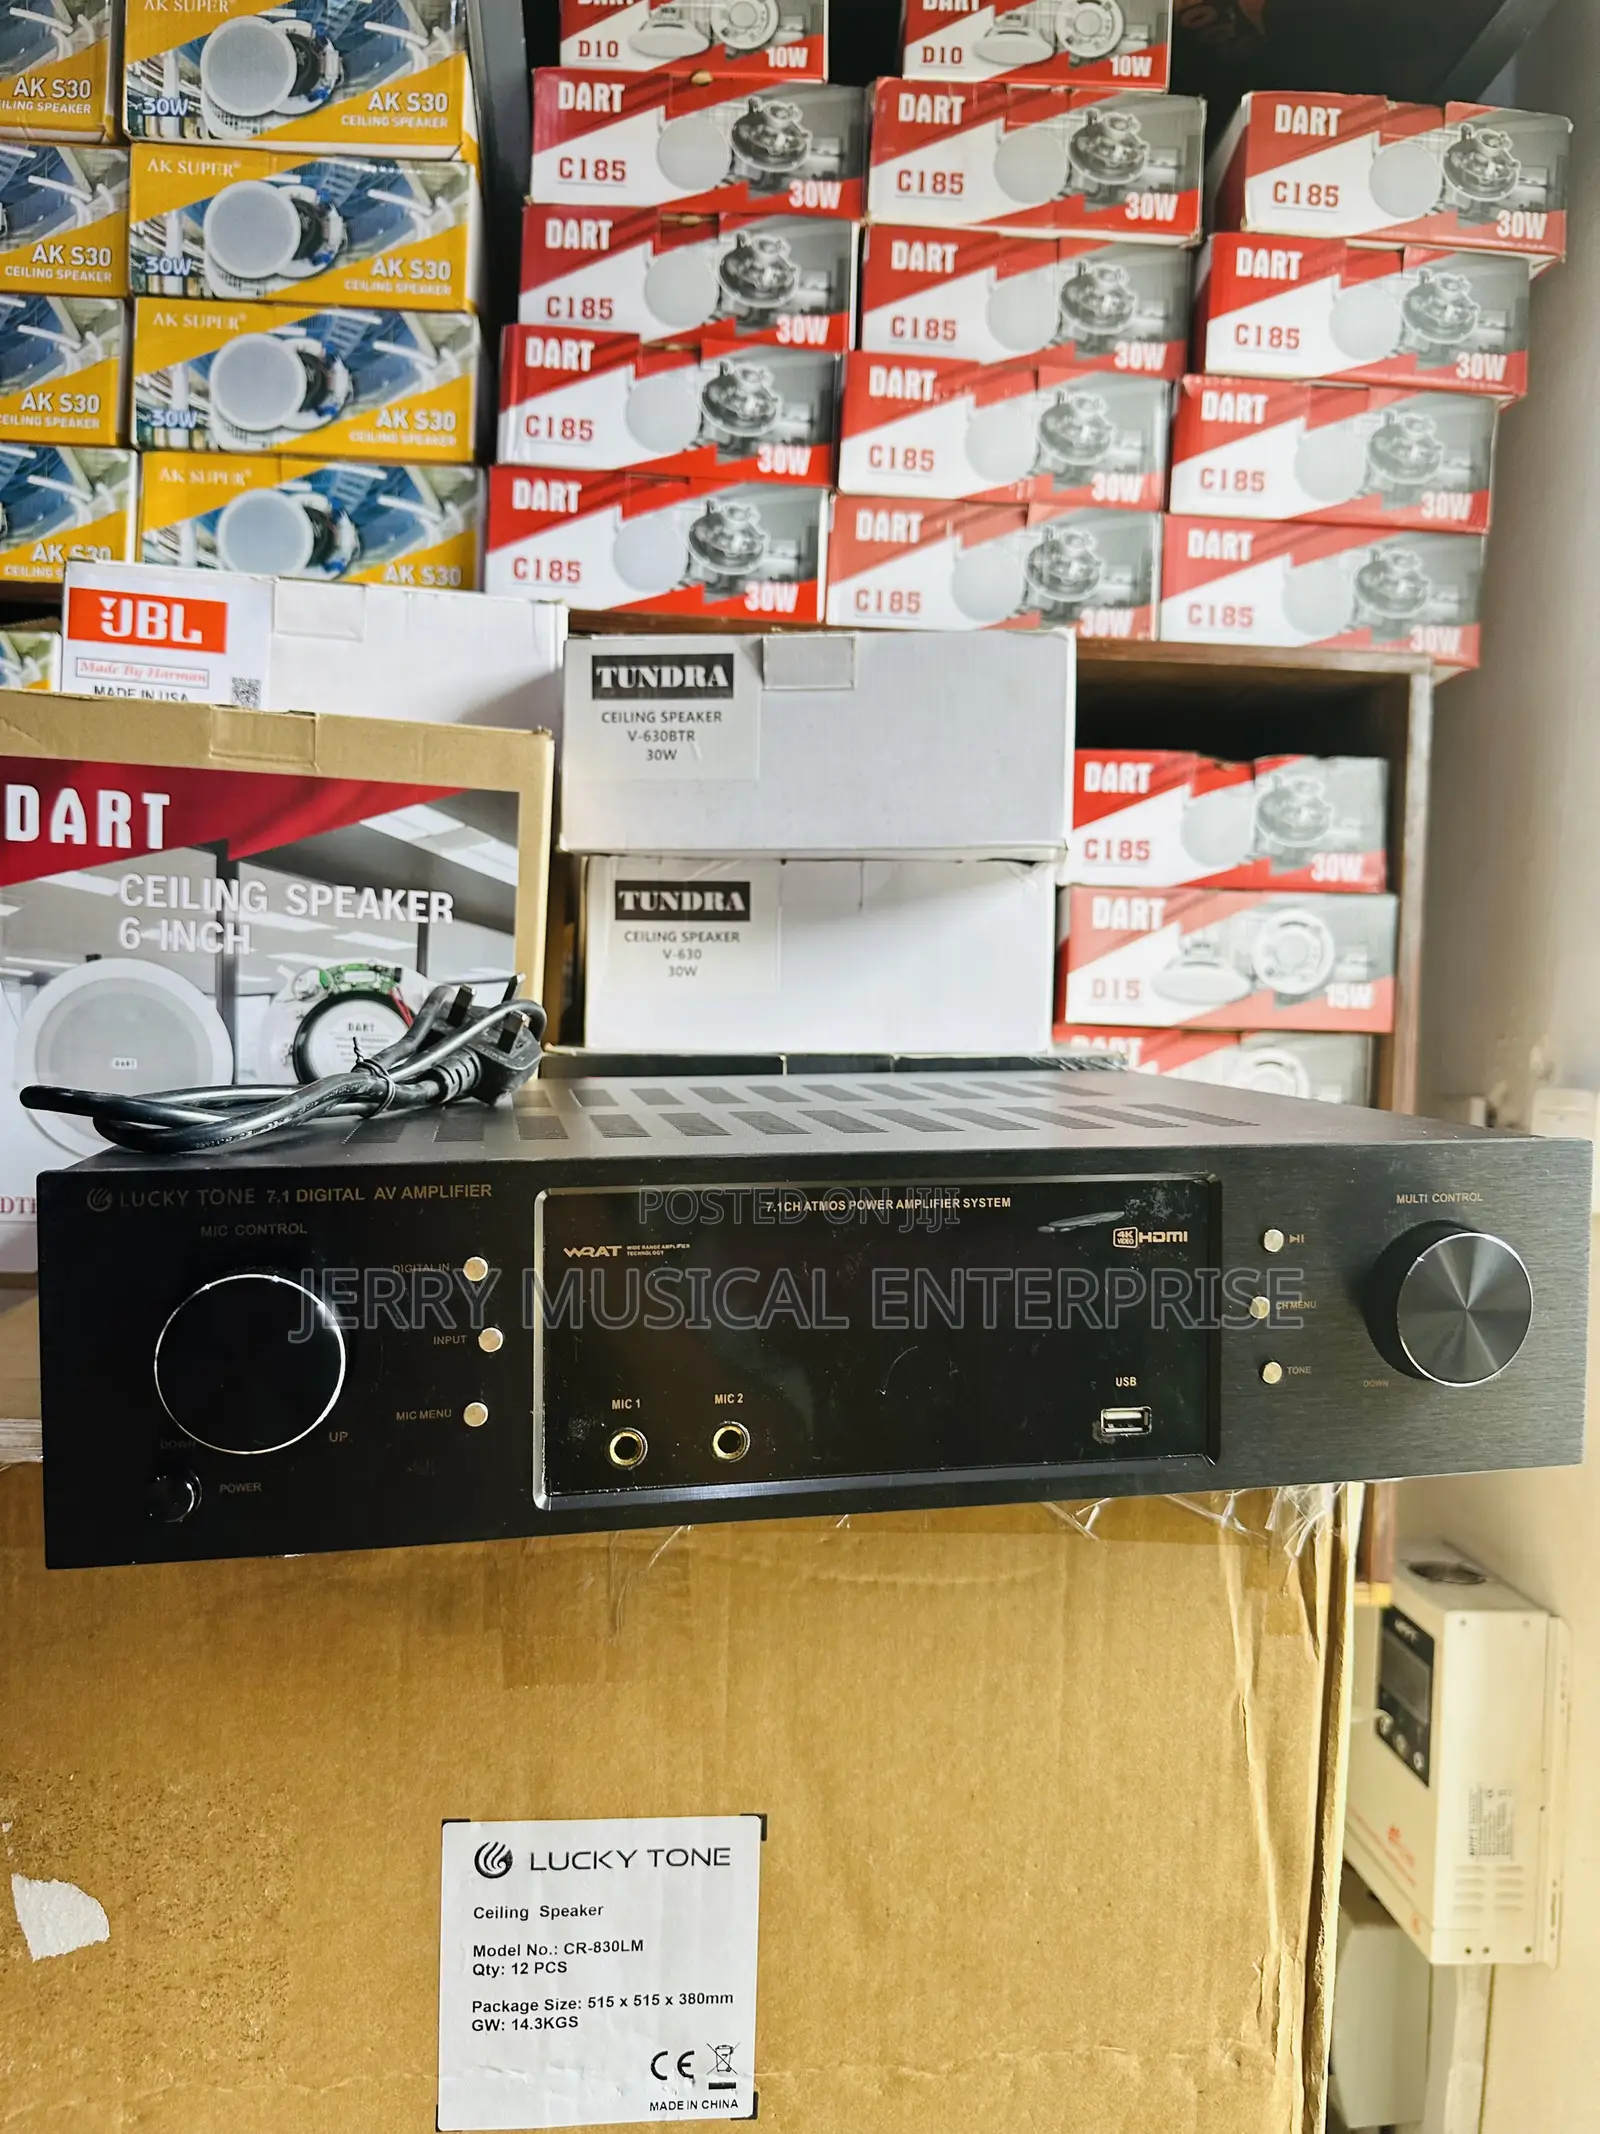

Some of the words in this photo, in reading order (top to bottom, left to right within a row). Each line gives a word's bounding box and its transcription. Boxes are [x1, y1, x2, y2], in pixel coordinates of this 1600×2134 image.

[578, 41, 619, 57] D10
[765, 47, 808, 68] 10W
[922, 47, 963, 64] D10
[1110, 55, 1153, 77] 10W
[13, 76, 46, 97] AK
[52, 79, 91, 99] S30
[558, 81, 625, 112] DART
[37, 103, 91, 114] SPEAKER
[368, 92, 400, 111] AK
[406, 93, 447, 112] S30
[898, 93, 966, 125] DART
[341, 115, 387, 125] CEILING
[392, 117, 448, 128] SPEAKER
[1275, 104, 1342, 137] DART
[147, 158, 172, 173] AK
[559, 157, 627, 181] C185
[897, 170, 964, 194] C185
[788, 182, 842, 209] 30W
[1273, 182, 1339, 207] C185
[1124, 193, 1178, 220] 30W
[545, 219, 613, 250] DART
[1496, 210, 1547, 239] 30W
[32, 244, 64, 264] AK
[71, 247, 111, 266] S30
[891, 240, 958, 273] DART
[1236, 248, 1303, 280] DART
[371, 258, 404, 278] AK
[410, 260, 451, 280] S30
[546, 296, 613, 320] C185
[776, 315, 829, 344] 30W
[892, 316, 957, 341] C185
[1235, 324, 1300, 349] C185
[525, 336, 595, 371] DART
[1114, 341, 1167, 371] 30W
[1456, 352, 1506, 381] 30W
[869, 365, 936, 400] DART
[21, 391, 53, 411] AK
[60, 393, 100, 413] S30
[1201, 390, 1268, 424] DART
[376, 408, 409, 428] AK
[414, 410, 456, 431] S30
[526, 415, 593, 440] C185
[757, 444, 811, 475] 30W
[869, 445, 934, 470] C185
[1091, 472, 1144, 503] 30W
[1201, 467, 1265, 492] C185
[512, 478, 582, 513] DART
[1421, 492, 1473, 520] 30W
[855, 509, 923, 543] DART
[1187, 529, 1254, 561] DART
[513, 558, 582, 582] C185
[744, 582, 798, 613] 30W
[855, 590, 920, 613] C185
[100, 597, 202, 644] JBL
[1080, 608, 1133, 638] 30W
[596, 665, 729, 688] TUNDRA
[601, 712, 656, 723] CEILING
[661, 711, 722, 723] SPEAKER
[627, 730, 695, 742] V-630BTR
[646, 749, 677, 761] 30W
[1084, 762, 1153, 794] DART
[4, 784, 171, 850] DART
[1084, 839, 1150, 861] C185
[119, 873, 268, 914] CEILING
[285, 884, 453, 924] SPEAKER
[618, 890, 745, 911] TUNDRA
[1092, 897, 1166, 930] DART
[160, 918, 251, 955] INCH
[624, 931, 677, 943] CEILING
[681, 931, 740, 943] SPEAKER
[663, 949, 702, 960] V-630
[668, 966, 697, 977] 30W
[1325, 983, 1374, 1010] 15W
[119, 1191, 188, 1208] LUCKY
[197, 1188, 256, 1206] TONE
[267, 1188, 289, 1204] 7.1
[296, 1187, 365, 1202] DIGITAL
[374, 1186, 398, 1200] AV
[400, 1184, 492, 1199] AMPLIFIER
[766, 1201, 800, 1213] 7.1CH
[803, 1200, 846, 1211] ATMOS
[849, 1198, 893, 1210] POWER
[896, 1198, 960, 1209] AMPLIFIER
[963, 1197, 1011, 1208] SYSTEM
[1396, 1194, 1428, 1204] MULTI
[1432, 1192, 1483, 1203] CONTROL
[200, 1224, 229, 1237] MIC
[235, 1223, 307, 1236] CONTROL
[1117, 1230, 1133, 1238] 4K
[1139, 1231, 1188, 1243] HDMI
[392, 1264, 436, 1273] DIGITAL
[438, 1263, 450, 1272] IN
[433, 1335, 467, 1345] INPUT
[1115, 1376, 1137, 1387] USB
[1287, 1366, 1311, 1375] TONE
[1363, 1379, 1389, 1388] DOWN
[612, 1400, 631, 1409] MIC
[636, 1399, 641, 1408] 1
[715, 1394, 734, 1404] MIC
[737, 1393, 743, 1403] 2
[396, 1410, 417, 1420] MIC
[418, 1409, 452, 1419] MENU
[329, 1431, 348, 1442] UP
[219, 1482, 262, 1493] POWER
[530, 1849, 637, 1871] LUCKY
[647, 1848, 731, 1868] TONE
[474, 1906, 529, 1921] Ceiling
[540, 1904, 604, 1920] Speaker
[474, 1944, 521, 1957] Model
[527, 1943, 558, 1956] No.:
[564, 1940, 643, 1955] CR-830LM
[473, 1963, 505, 1978] Qty:
[511, 1963, 528, 1974] 12
[535, 1961, 567, 1974] PCS
[472, 2000, 539, 2015] Package
[544, 1998, 582, 2010] Size:
[588, 1996, 614, 2008] 515
[620, 1998, 628, 2007] x
[633, 1995, 660, 2006] 515
[665, 1996, 673, 2005] x
[679, 1992, 734, 2005] 380mm
[472, 2019, 505, 2032] GW:
[512, 2016, 579, 2030] 14.3KGS
[650, 2101, 684, 2112] MADE
[687, 2100, 697, 2110] IN
[701, 2099, 739, 2110] CHINA
